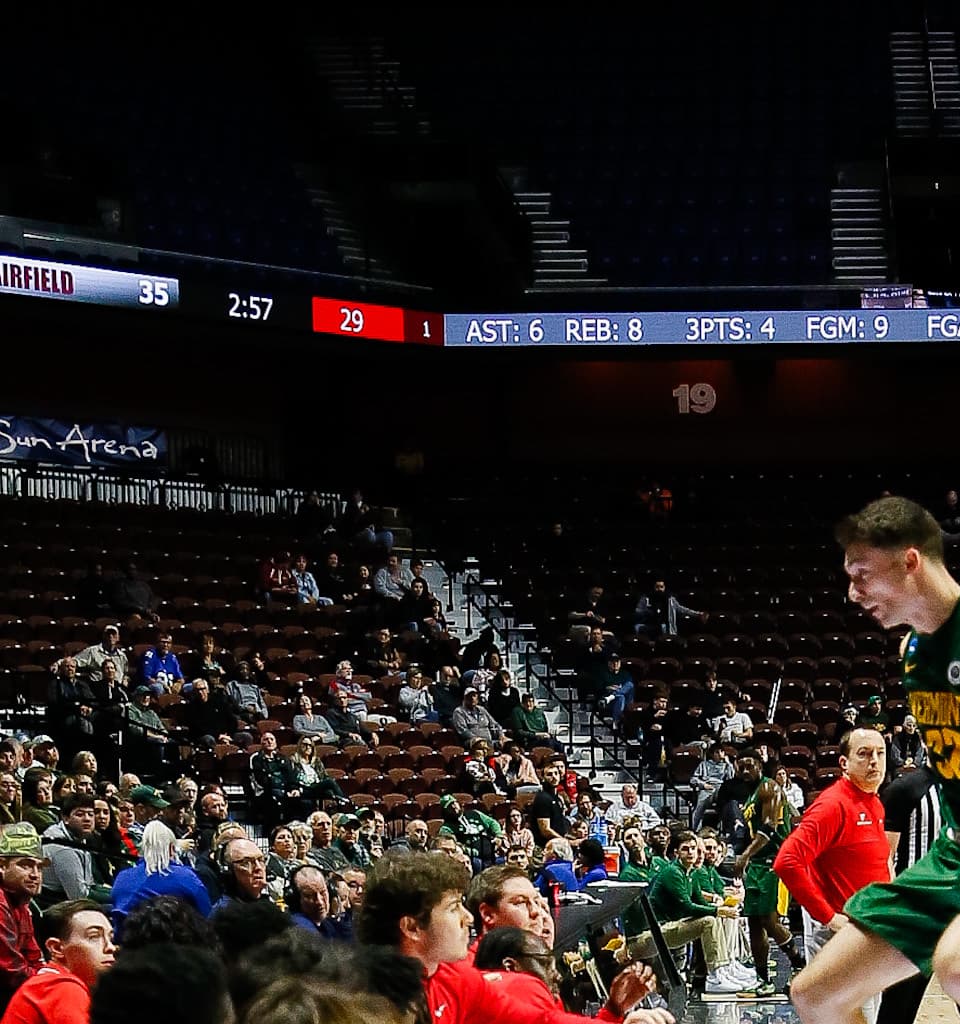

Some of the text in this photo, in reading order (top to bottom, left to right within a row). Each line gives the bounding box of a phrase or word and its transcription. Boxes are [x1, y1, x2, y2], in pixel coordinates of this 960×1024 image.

[0, 263, 74, 296] IRFIELD
[138, 280, 169, 306] 35
[228, 293, 273, 321] 2:57
[340, 308, 364, 333] 29
[422, 320, 431, 338] 1
[466, 320, 520, 343] AST:
[529, 320, 543, 342] 6
[566, 320, 620, 342] REB:
[629, 319, 643, 341] 8
[686, 318, 752, 341] 3PTS:
[760, 318, 775, 340] 4
[807, 317, 867, 340] FGM:
[874, 316, 888, 339] 9
[673, 383, 717, 413] 19
[56, 424, 158, 462] Arena
